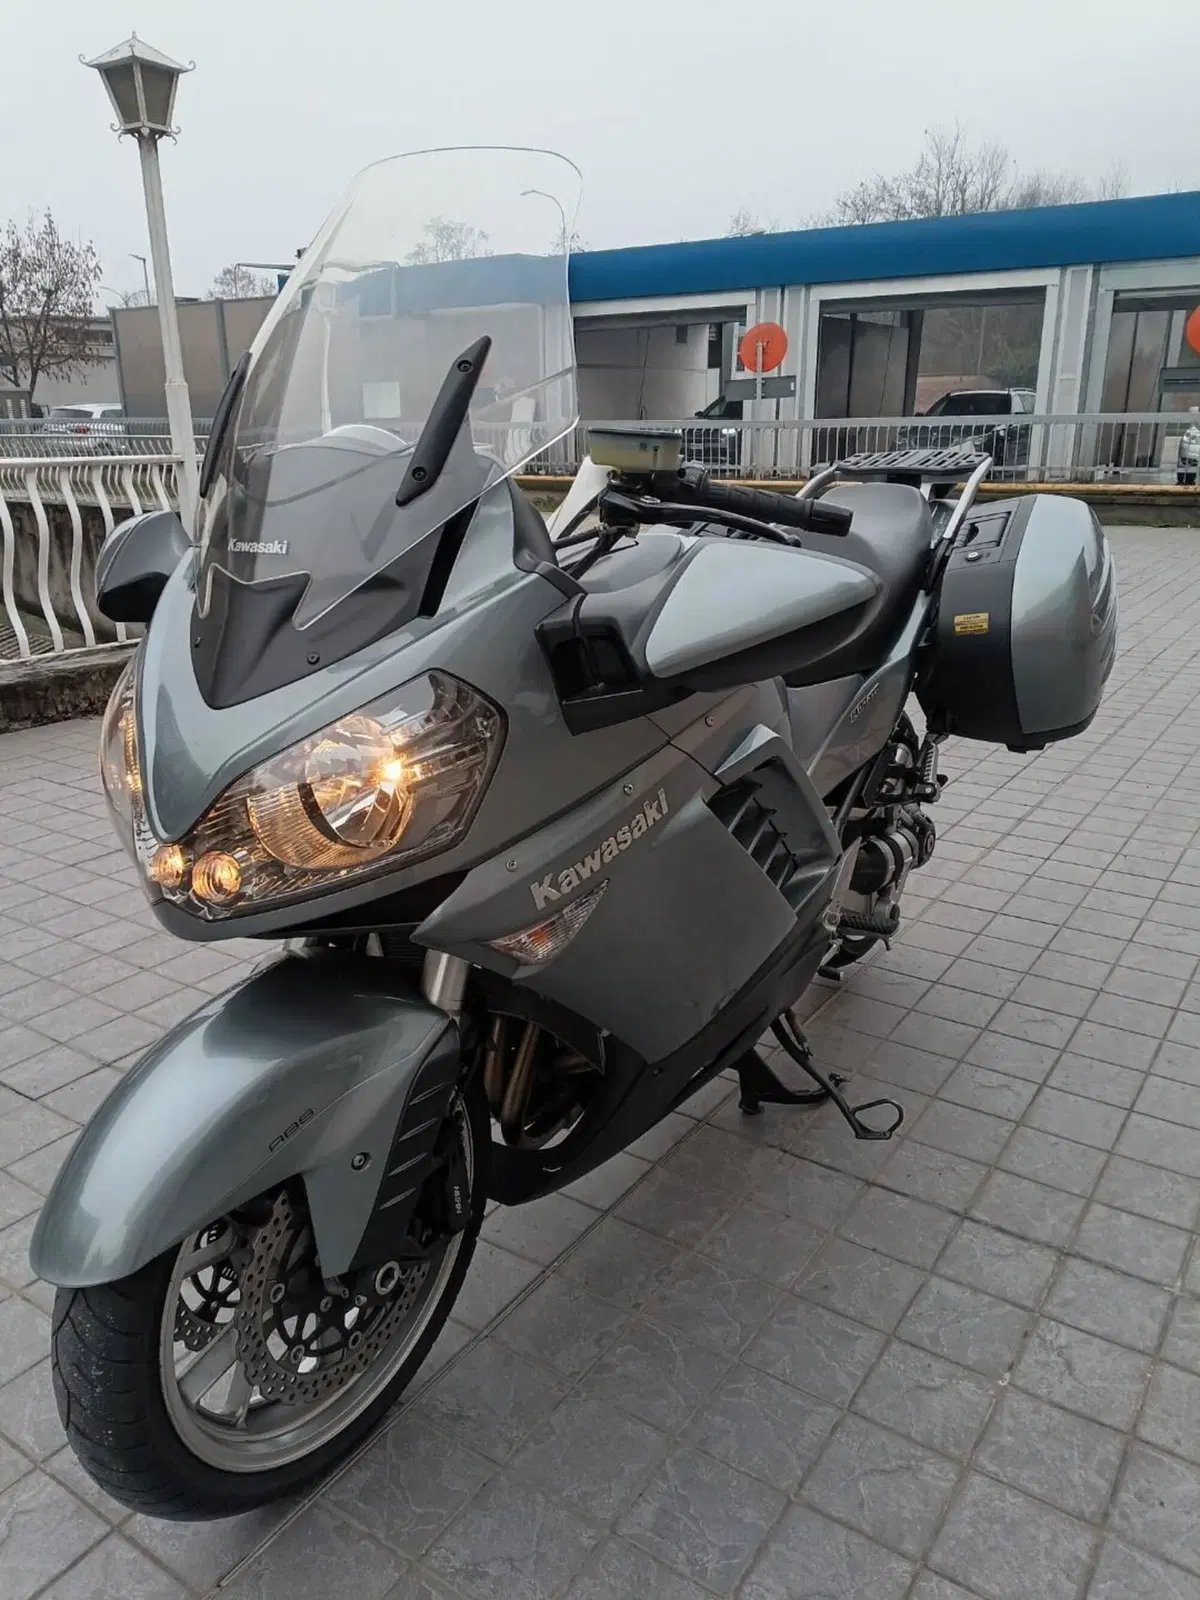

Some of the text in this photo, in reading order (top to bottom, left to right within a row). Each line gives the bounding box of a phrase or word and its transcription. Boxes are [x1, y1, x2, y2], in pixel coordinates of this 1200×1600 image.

[227, 538, 288, 554] Kawasaki
[530, 788, 669, 911] Kawasaki
[268, 1108, 314, 1152] ABS
